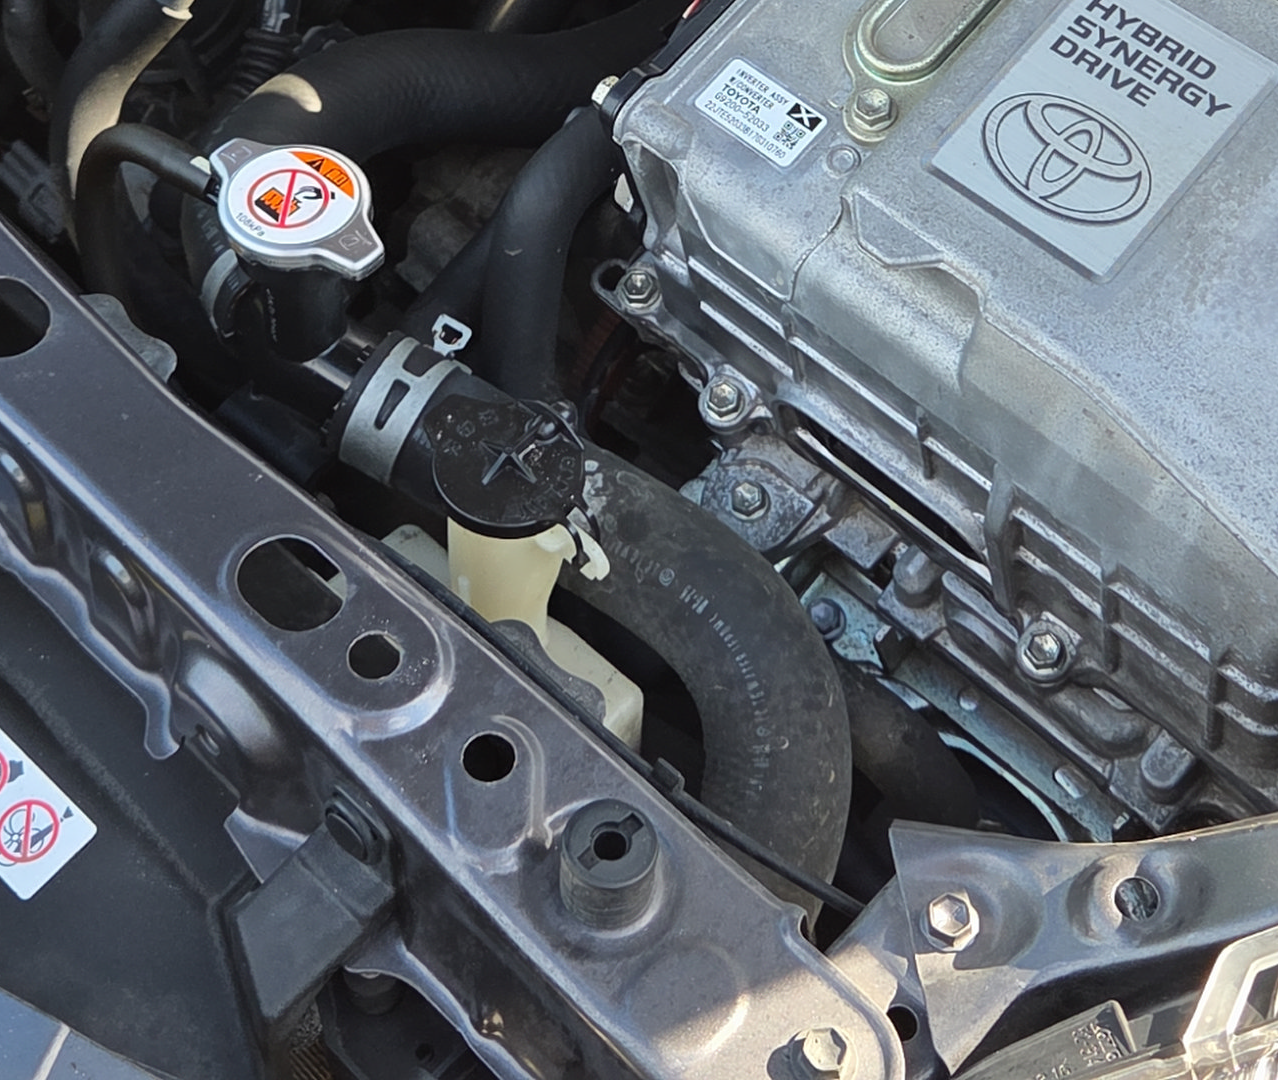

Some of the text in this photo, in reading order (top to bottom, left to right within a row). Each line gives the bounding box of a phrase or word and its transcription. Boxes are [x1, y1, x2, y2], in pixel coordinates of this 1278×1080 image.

[734, 67, 790, 107] INVERTER ASSY
[1048, 32, 1157, 109] DRIVE
[1066, 11, 1232, 124] SYNERGY
[712, 89, 771, 133] G9200-52033
[718, 82, 763, 115] TOYOTA
